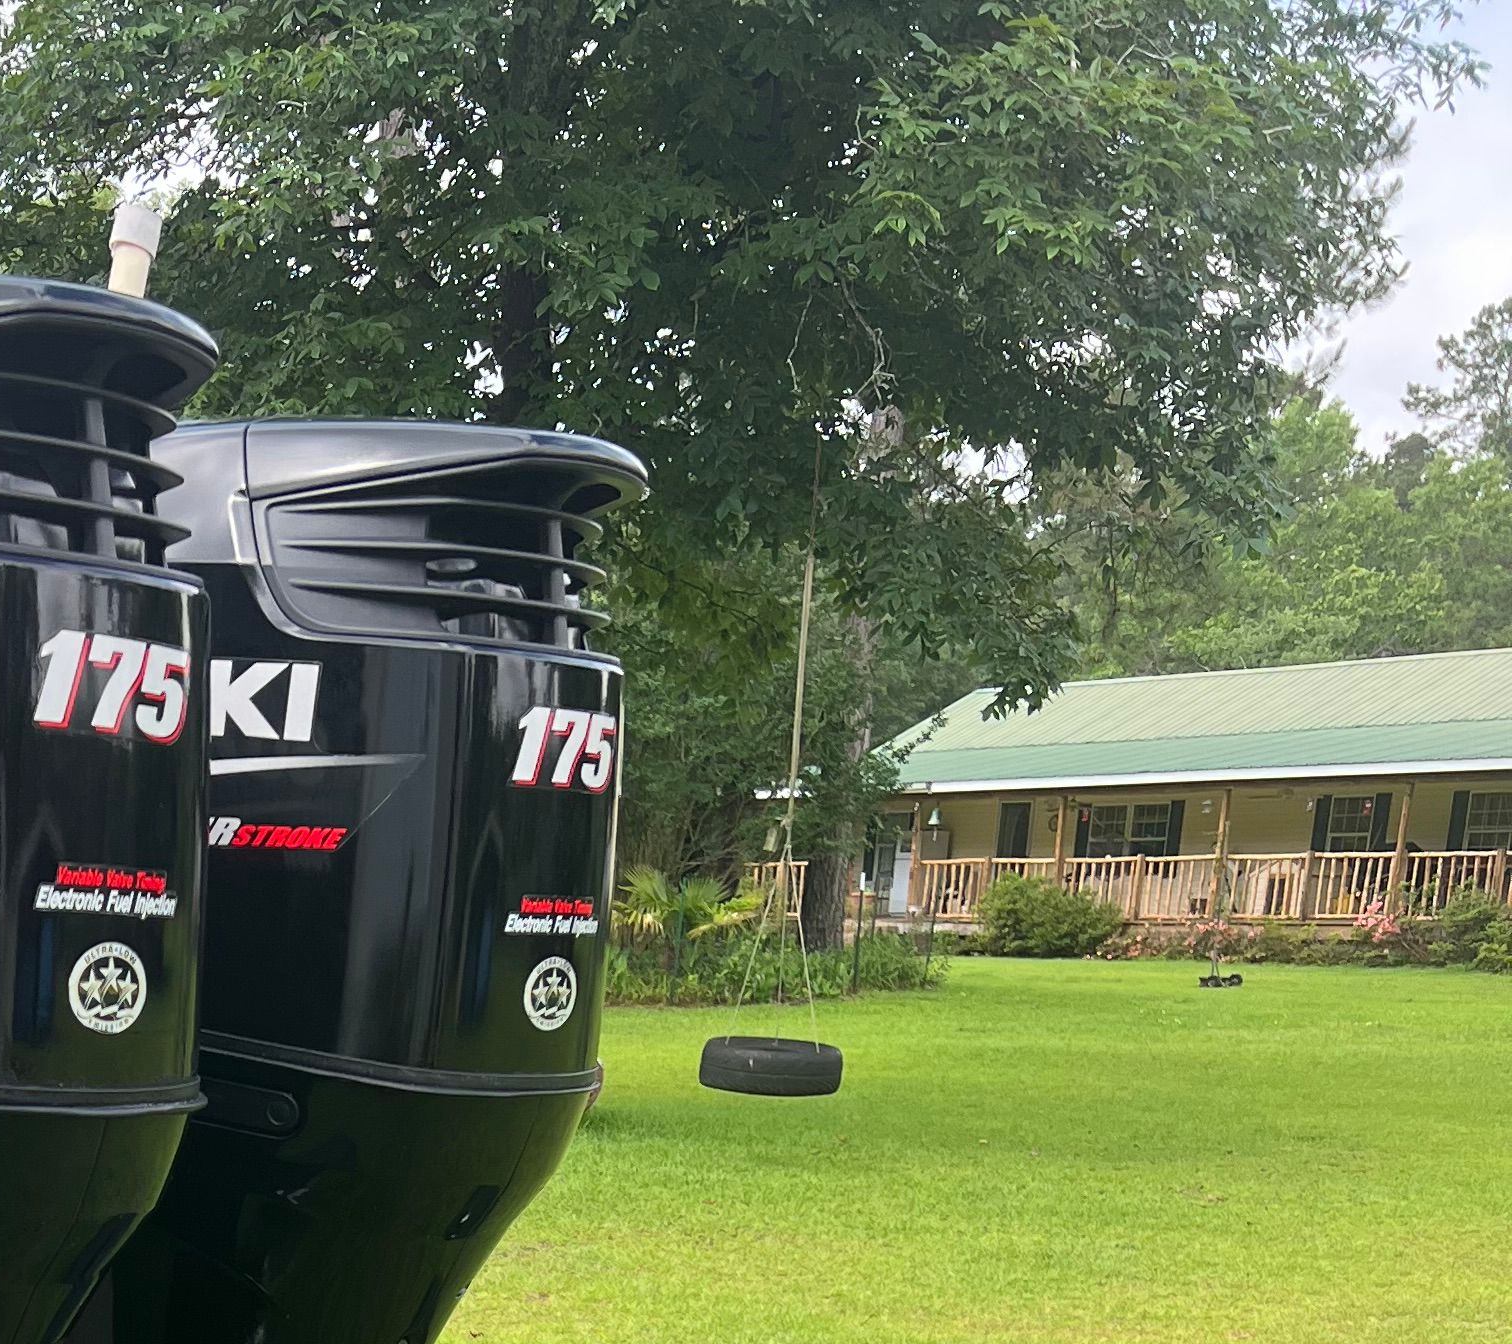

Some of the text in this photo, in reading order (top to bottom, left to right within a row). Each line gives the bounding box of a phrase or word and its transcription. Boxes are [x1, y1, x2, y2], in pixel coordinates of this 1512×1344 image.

[33, 629, 190, 745] 175
[510, 706, 617, 794] 175
[58, 865, 104, 887] Variable
[106, 868, 133, 889] Valve
[35, 884, 177, 920] Electronic Fuel Injection
[504, 913, 553, 933] Electronic
[553, 914, 573, 934] Fuel
